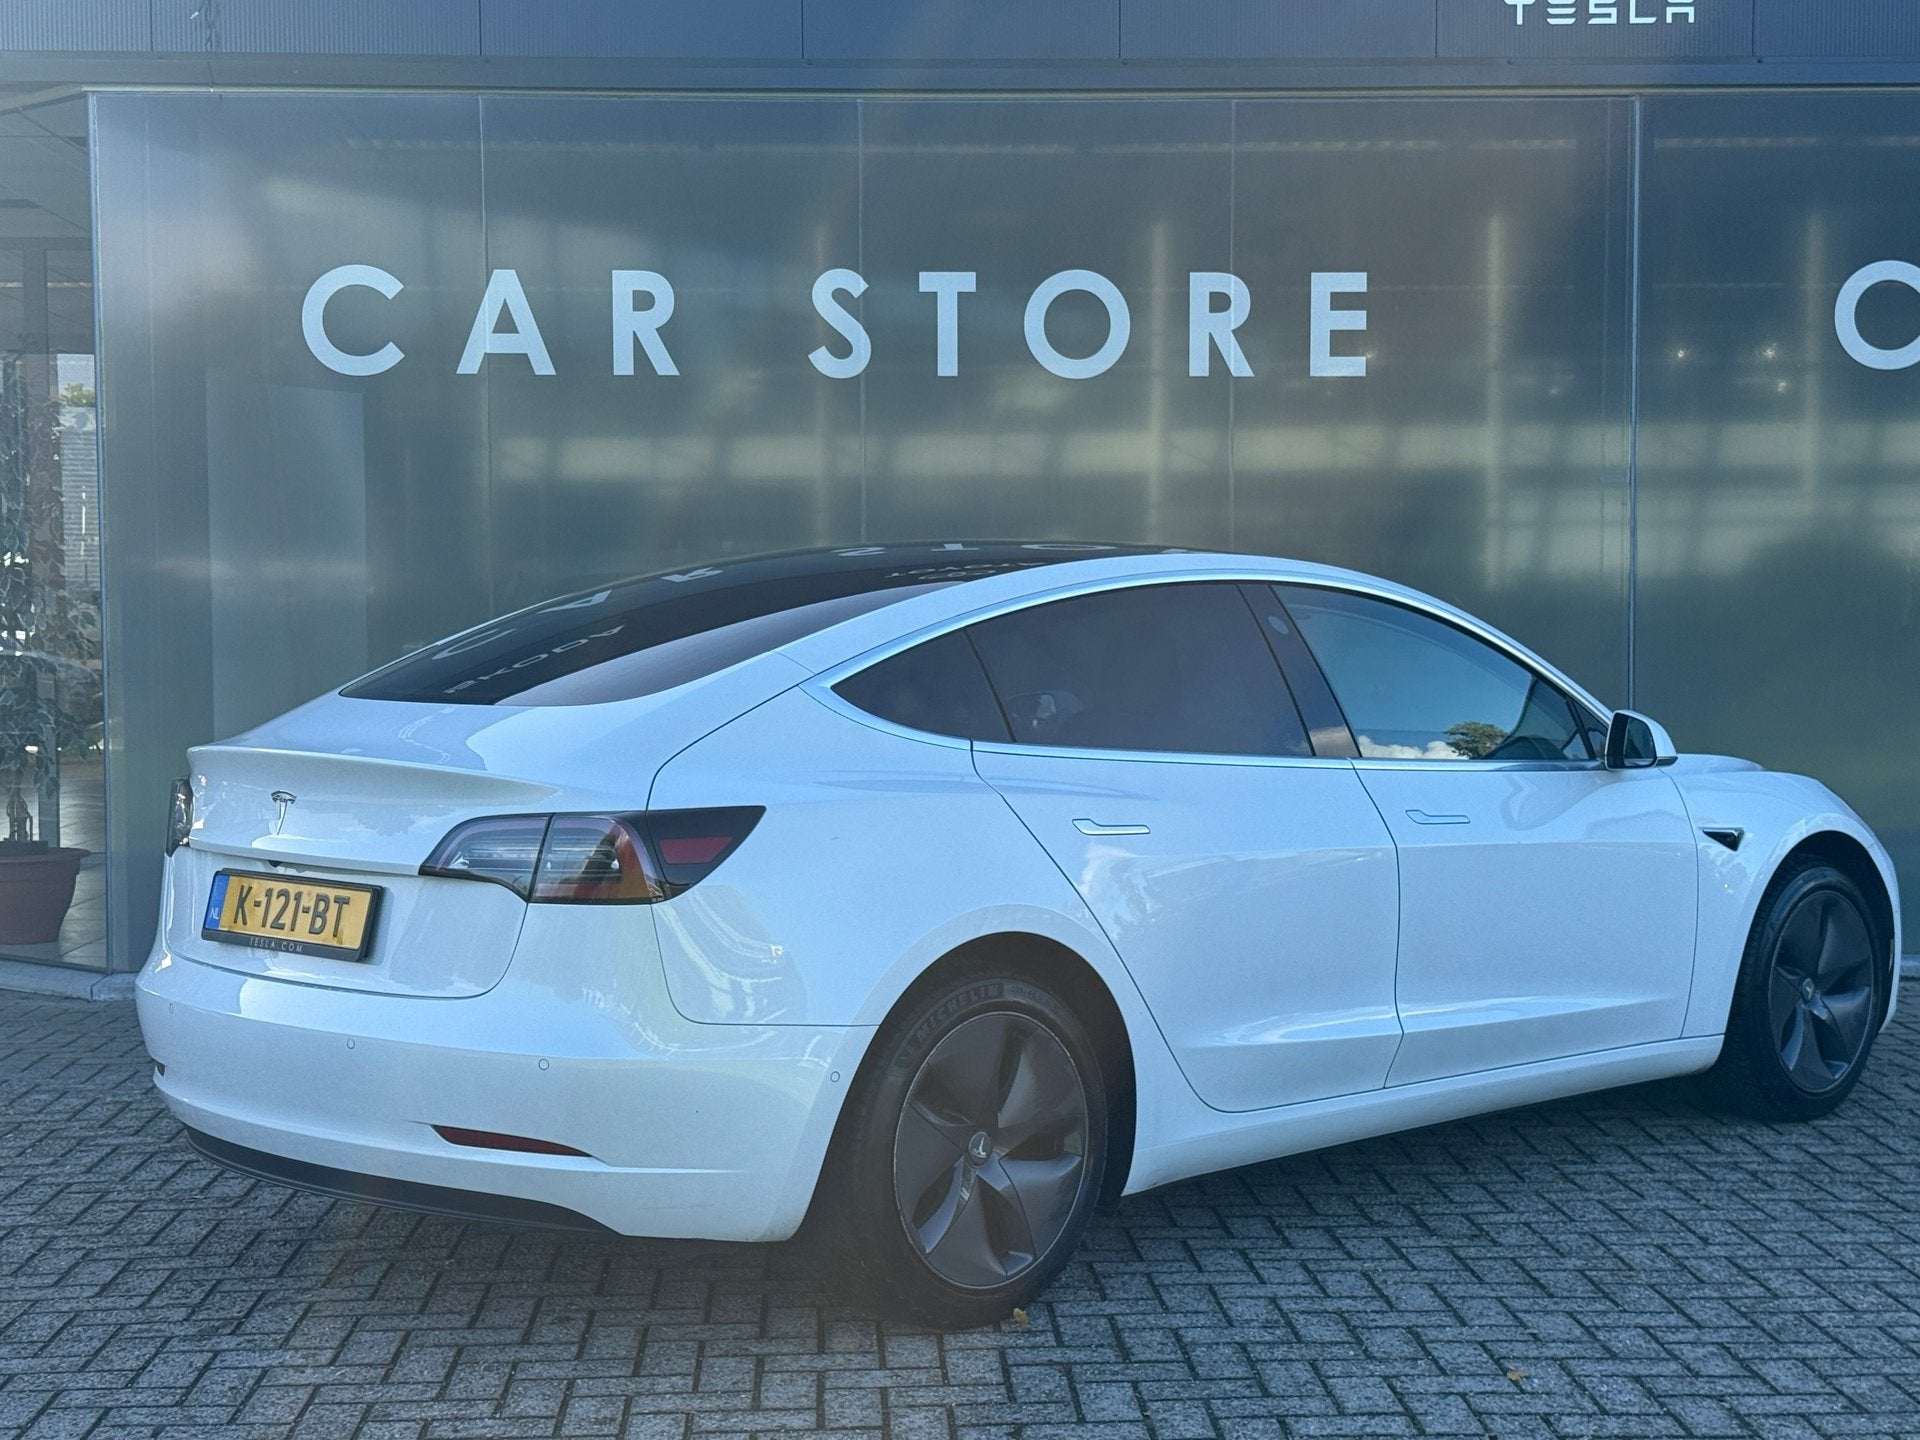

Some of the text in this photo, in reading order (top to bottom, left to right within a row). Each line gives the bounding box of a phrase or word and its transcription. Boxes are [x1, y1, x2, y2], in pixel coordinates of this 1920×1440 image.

[1504, 0, 1695, 25] TESLA
[302, 264, 1368, 379] CAR STORE
[209, 906, 220, 920] NL
[232, 883, 351, 938] K-121-BT
